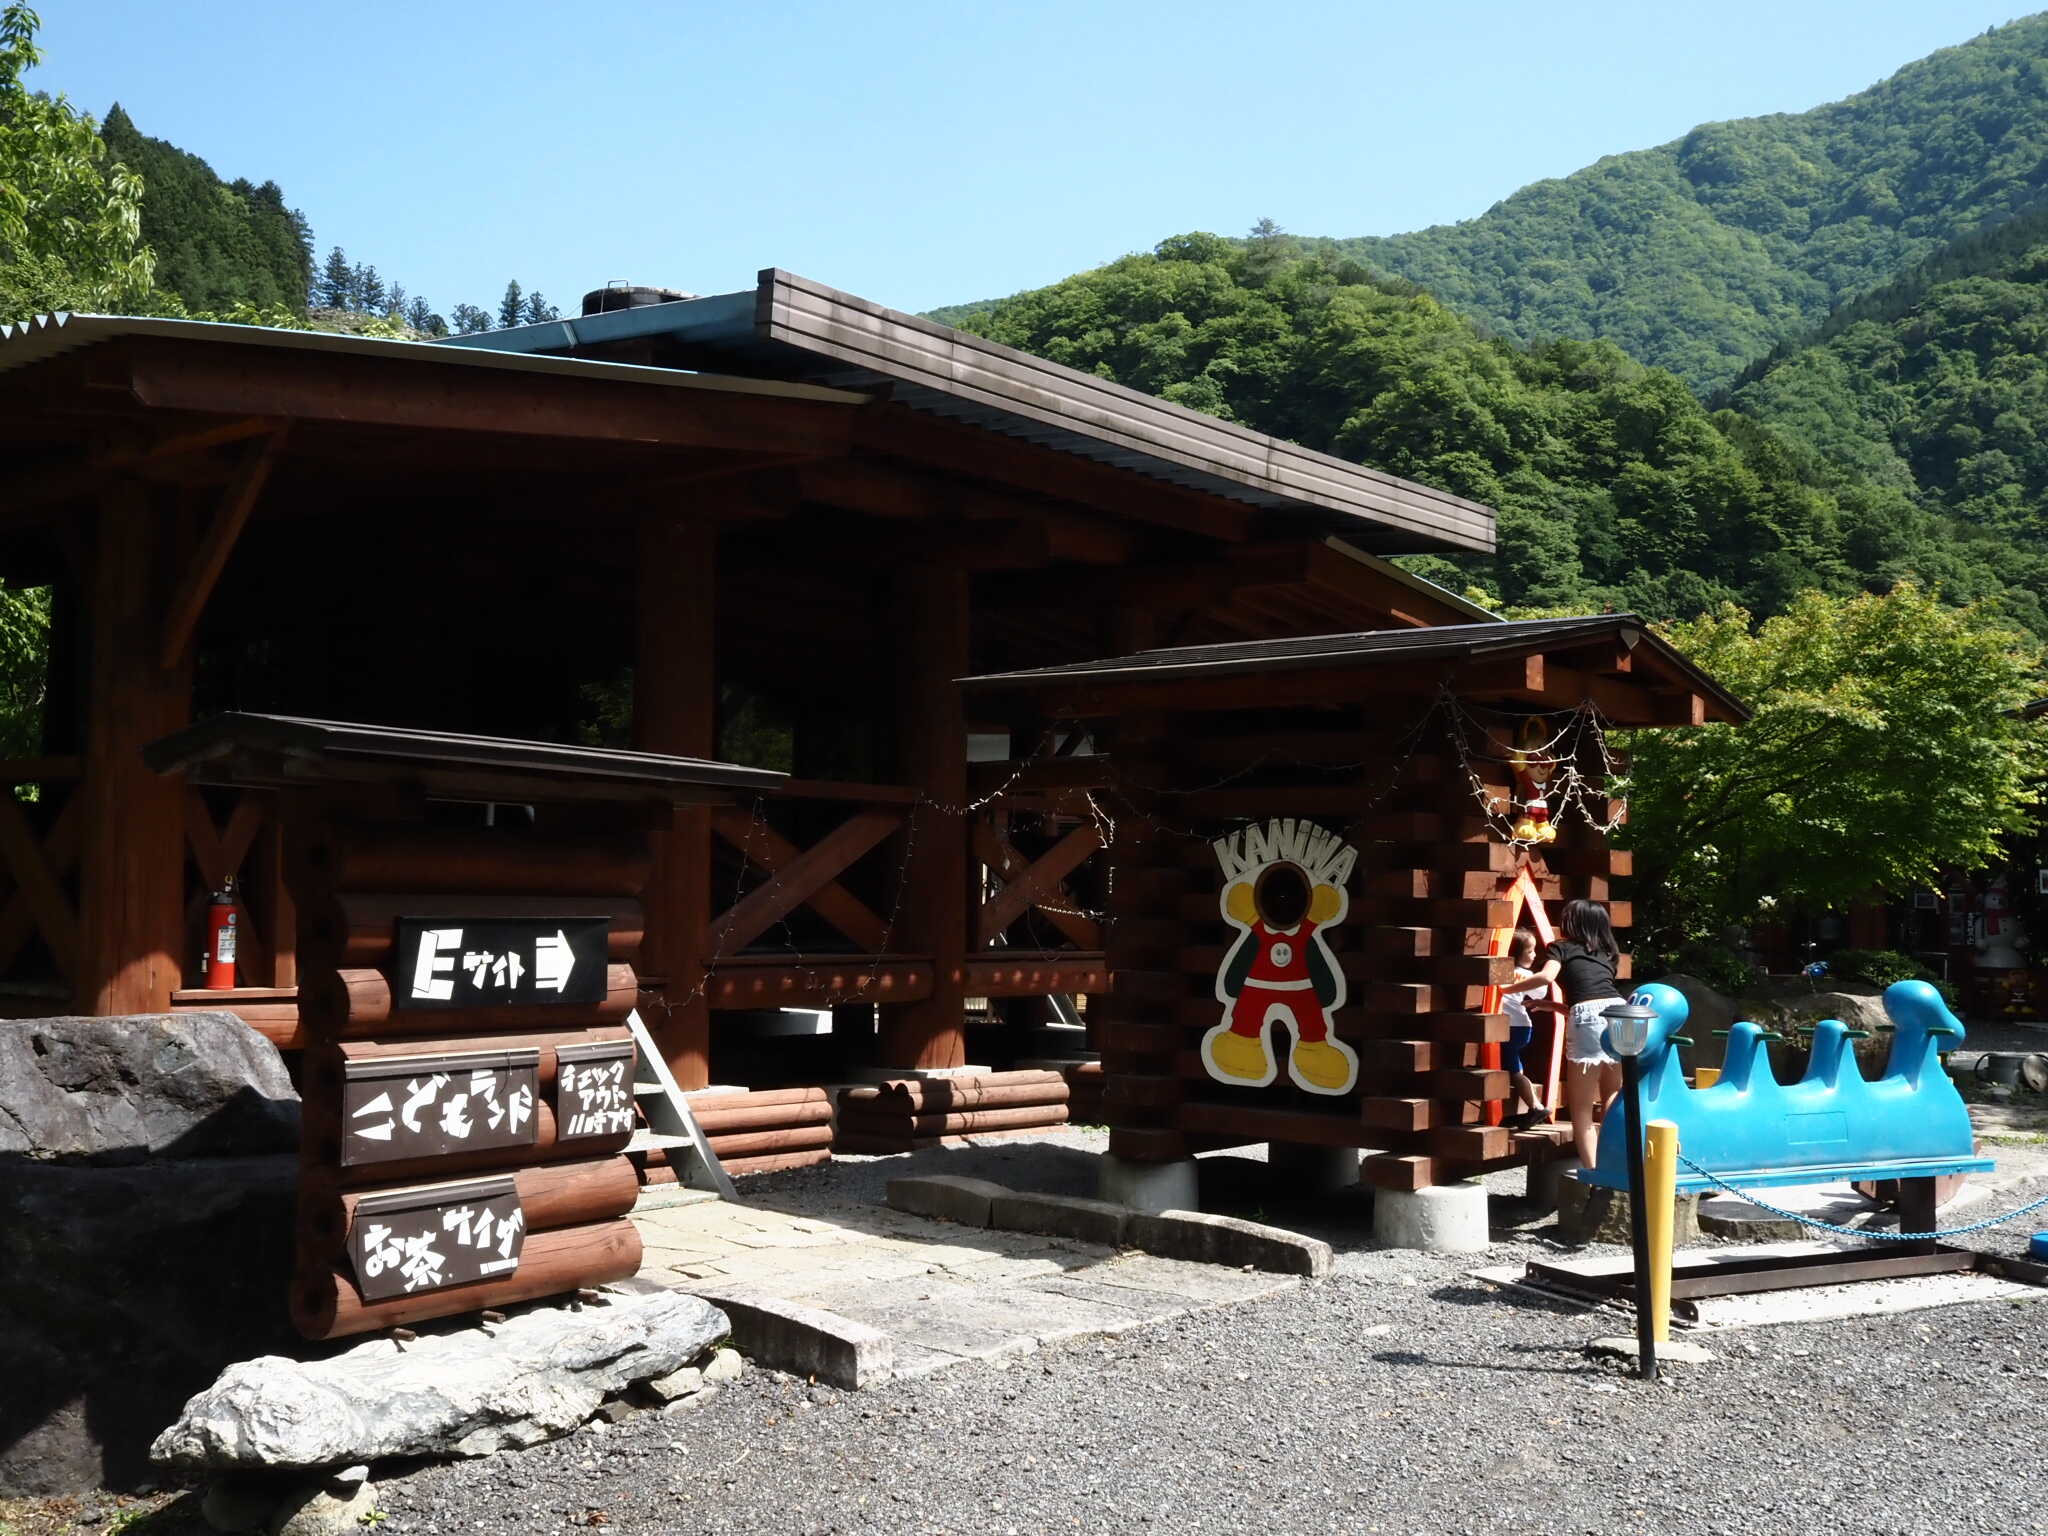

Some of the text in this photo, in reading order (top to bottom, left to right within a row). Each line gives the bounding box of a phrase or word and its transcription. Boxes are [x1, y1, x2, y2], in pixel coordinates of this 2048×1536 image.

[561, 1060, 625, 1092] チェック
[352, 1069, 533, 1139] こどもランド
[578, 1085, 628, 1111] アウト
[567, 1107, 634, 1135] 11時です
